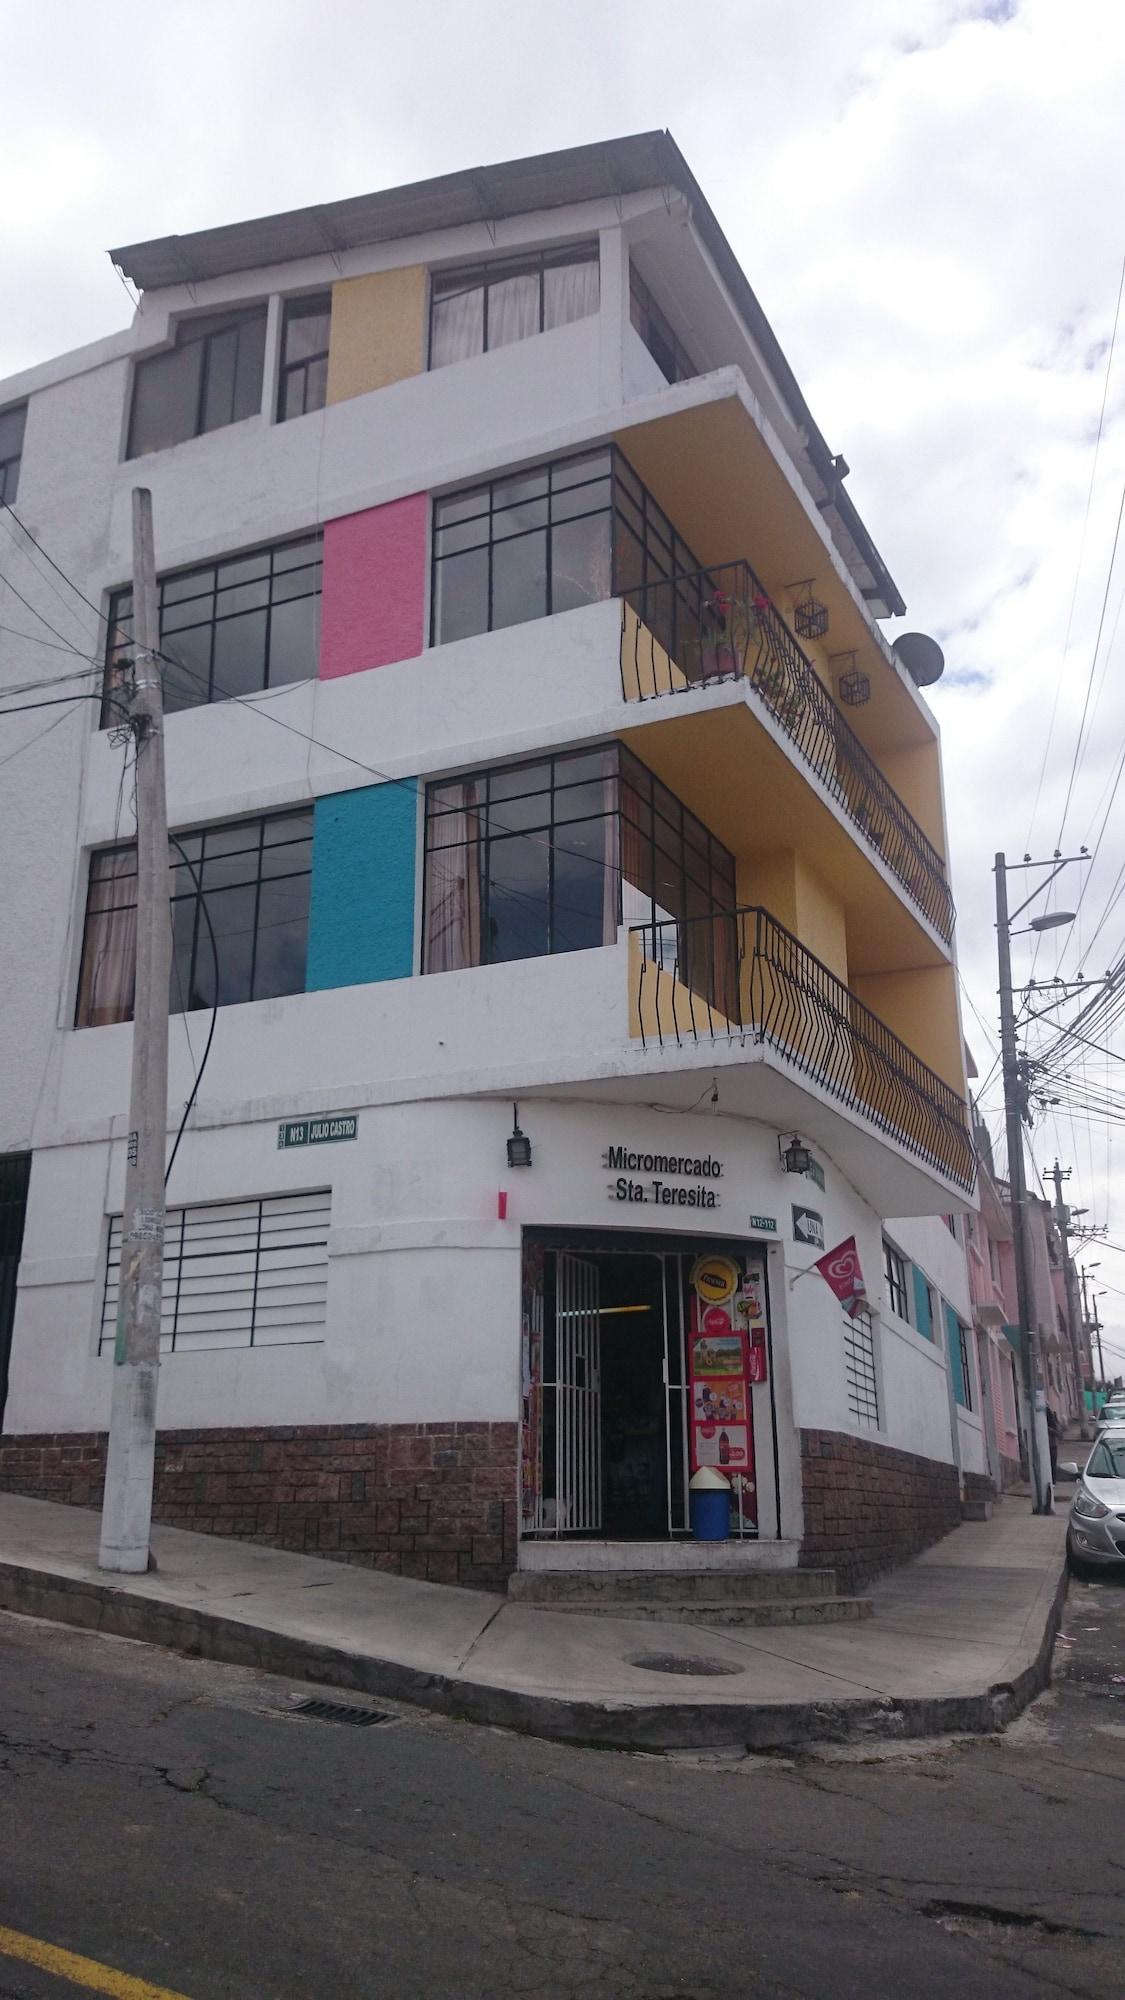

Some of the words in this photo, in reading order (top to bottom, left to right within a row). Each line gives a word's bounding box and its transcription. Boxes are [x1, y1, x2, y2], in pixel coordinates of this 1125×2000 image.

[290, 1126, 304, 1142] N13
[311, 1122, 329, 1139] JULIO
[330, 1119, 355, 1137] CASTRO
[608, 1145, 721, 1178] Micromercado
[616, 1177, 648, 1203] Sta.
[652, 1181, 716, 1208] Teresita
[751, 1217, 775, 1230] N12-112
